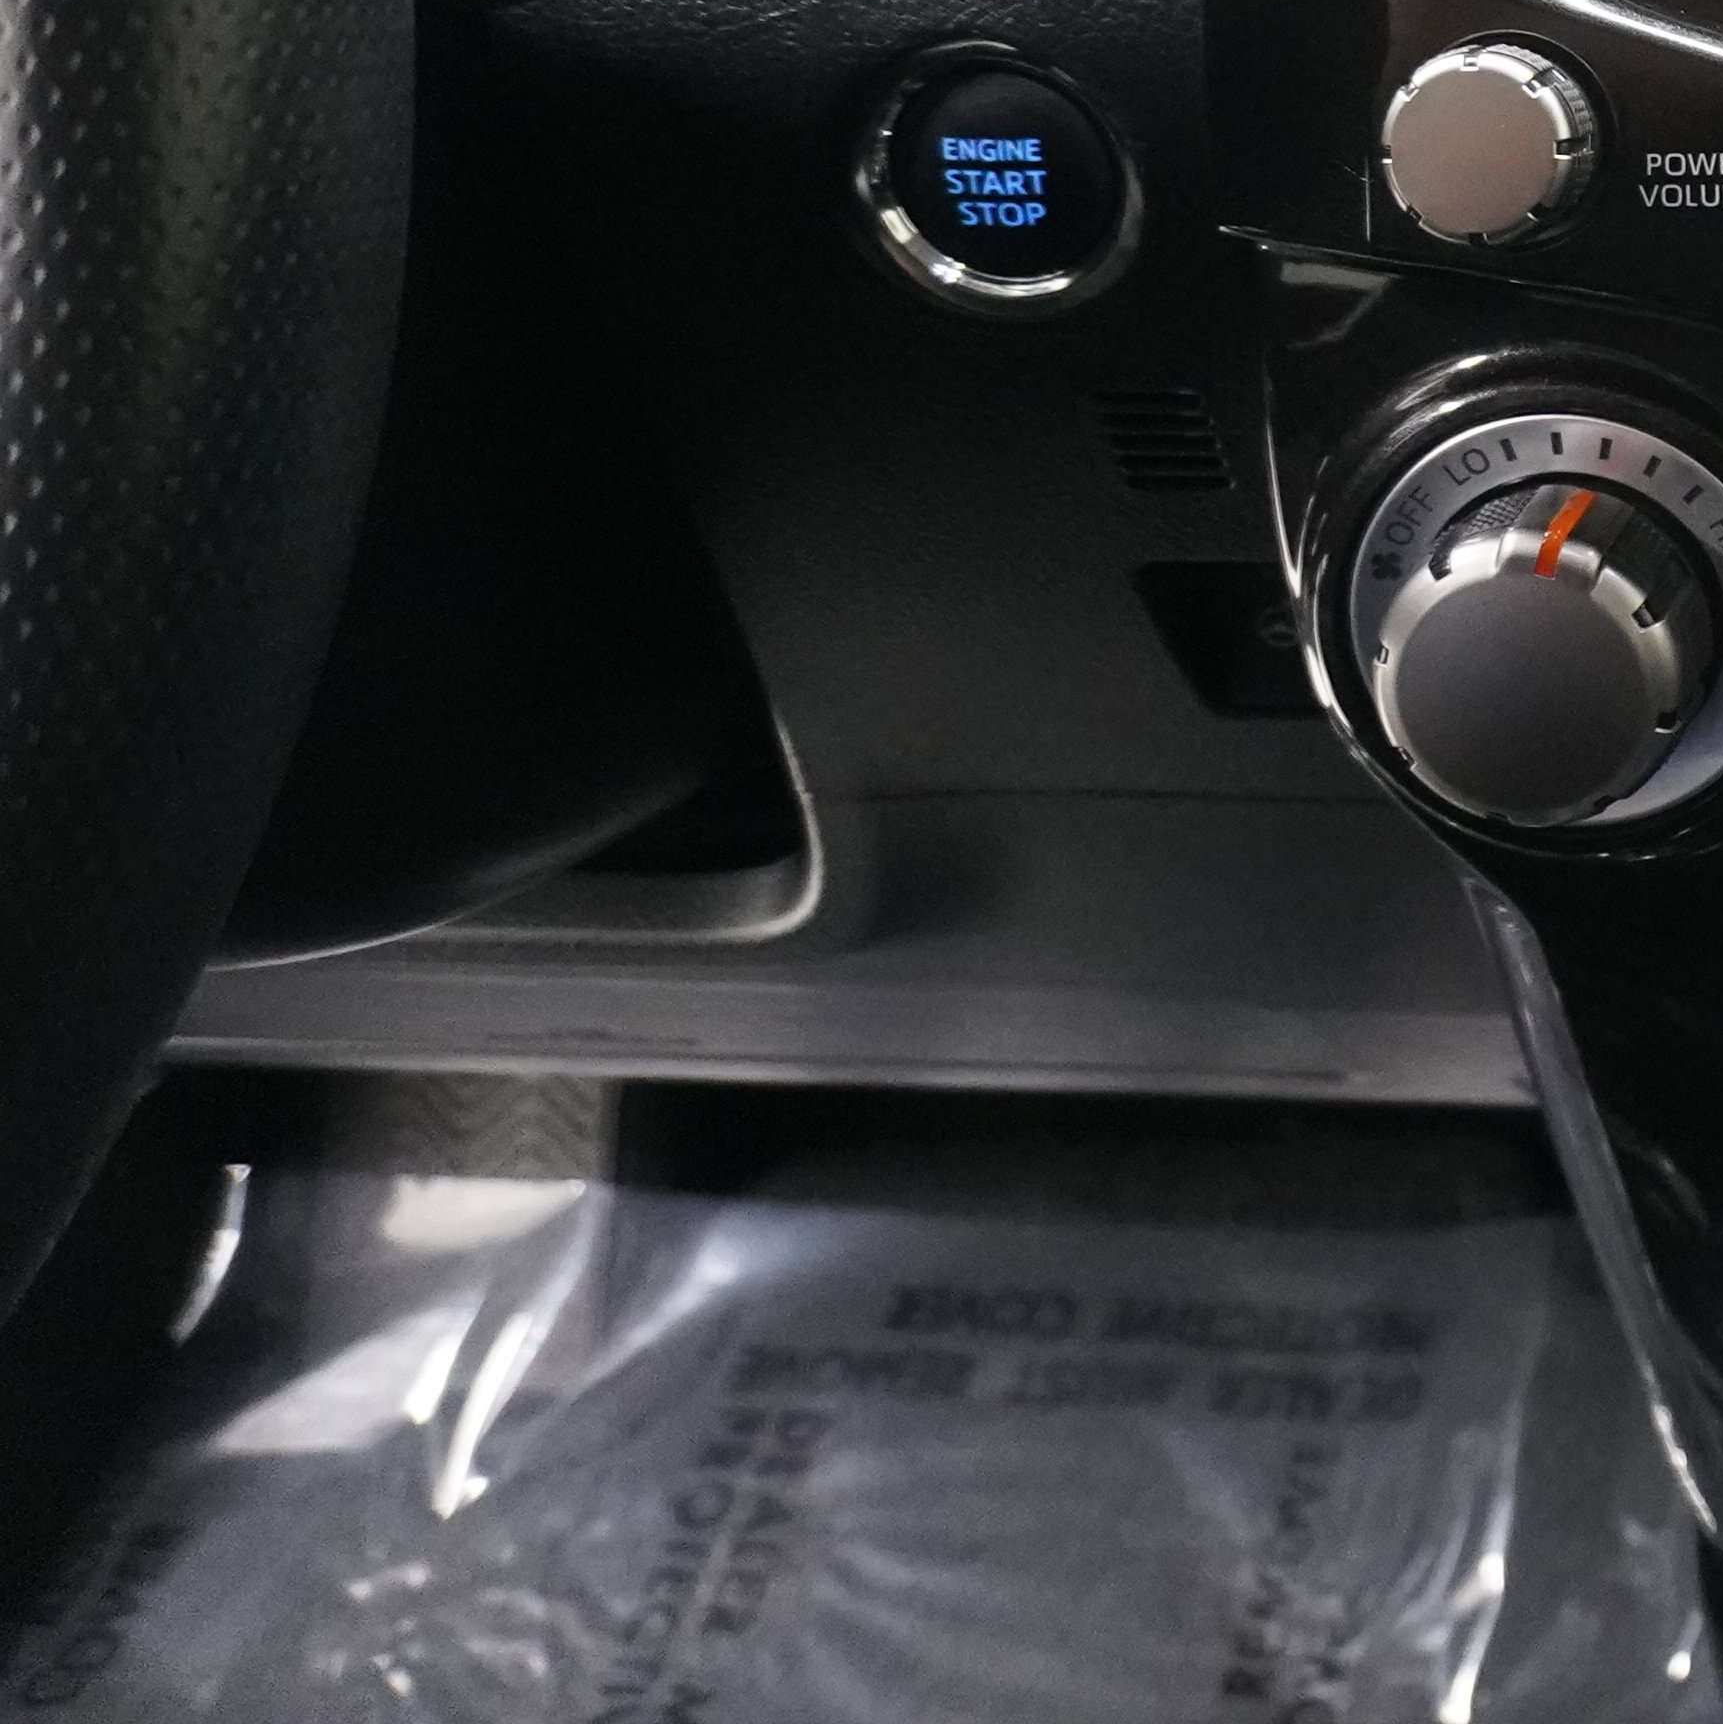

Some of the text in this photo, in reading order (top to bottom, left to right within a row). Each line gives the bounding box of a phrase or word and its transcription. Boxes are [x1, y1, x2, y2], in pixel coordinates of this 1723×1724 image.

[940, 136, 1043, 162] ENGINE
[944, 169, 1048, 196] START
[957, 201, 1048, 227] STOP
[1384, 447, 1491, 546] OFF LO
